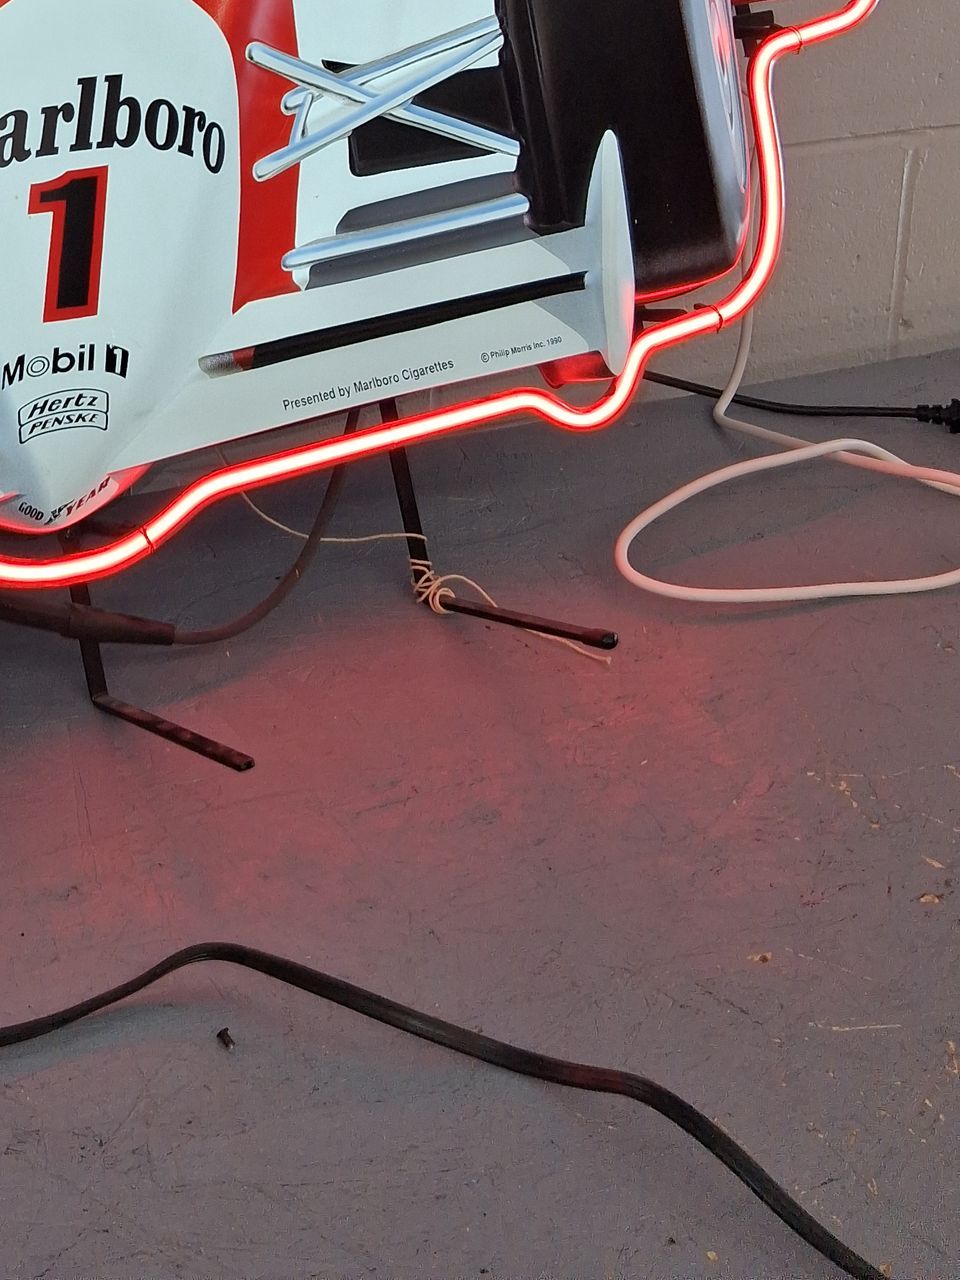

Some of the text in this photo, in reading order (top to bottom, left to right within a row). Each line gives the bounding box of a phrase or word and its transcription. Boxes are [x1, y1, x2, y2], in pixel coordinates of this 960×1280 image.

[28, 166, 108, 323] 1
[490, 349, 510, 359] Philip
[510, 343, 532, 354] Morris
[1, 343, 95, 390] Mobil
[282, 359, 455, 411] Presented by Marlboro Cigarettes
[28, 393, 98, 420] Hertz
[28, 413, 98, 435] PENSKE
[18, 501, 44, 521] GOOD
